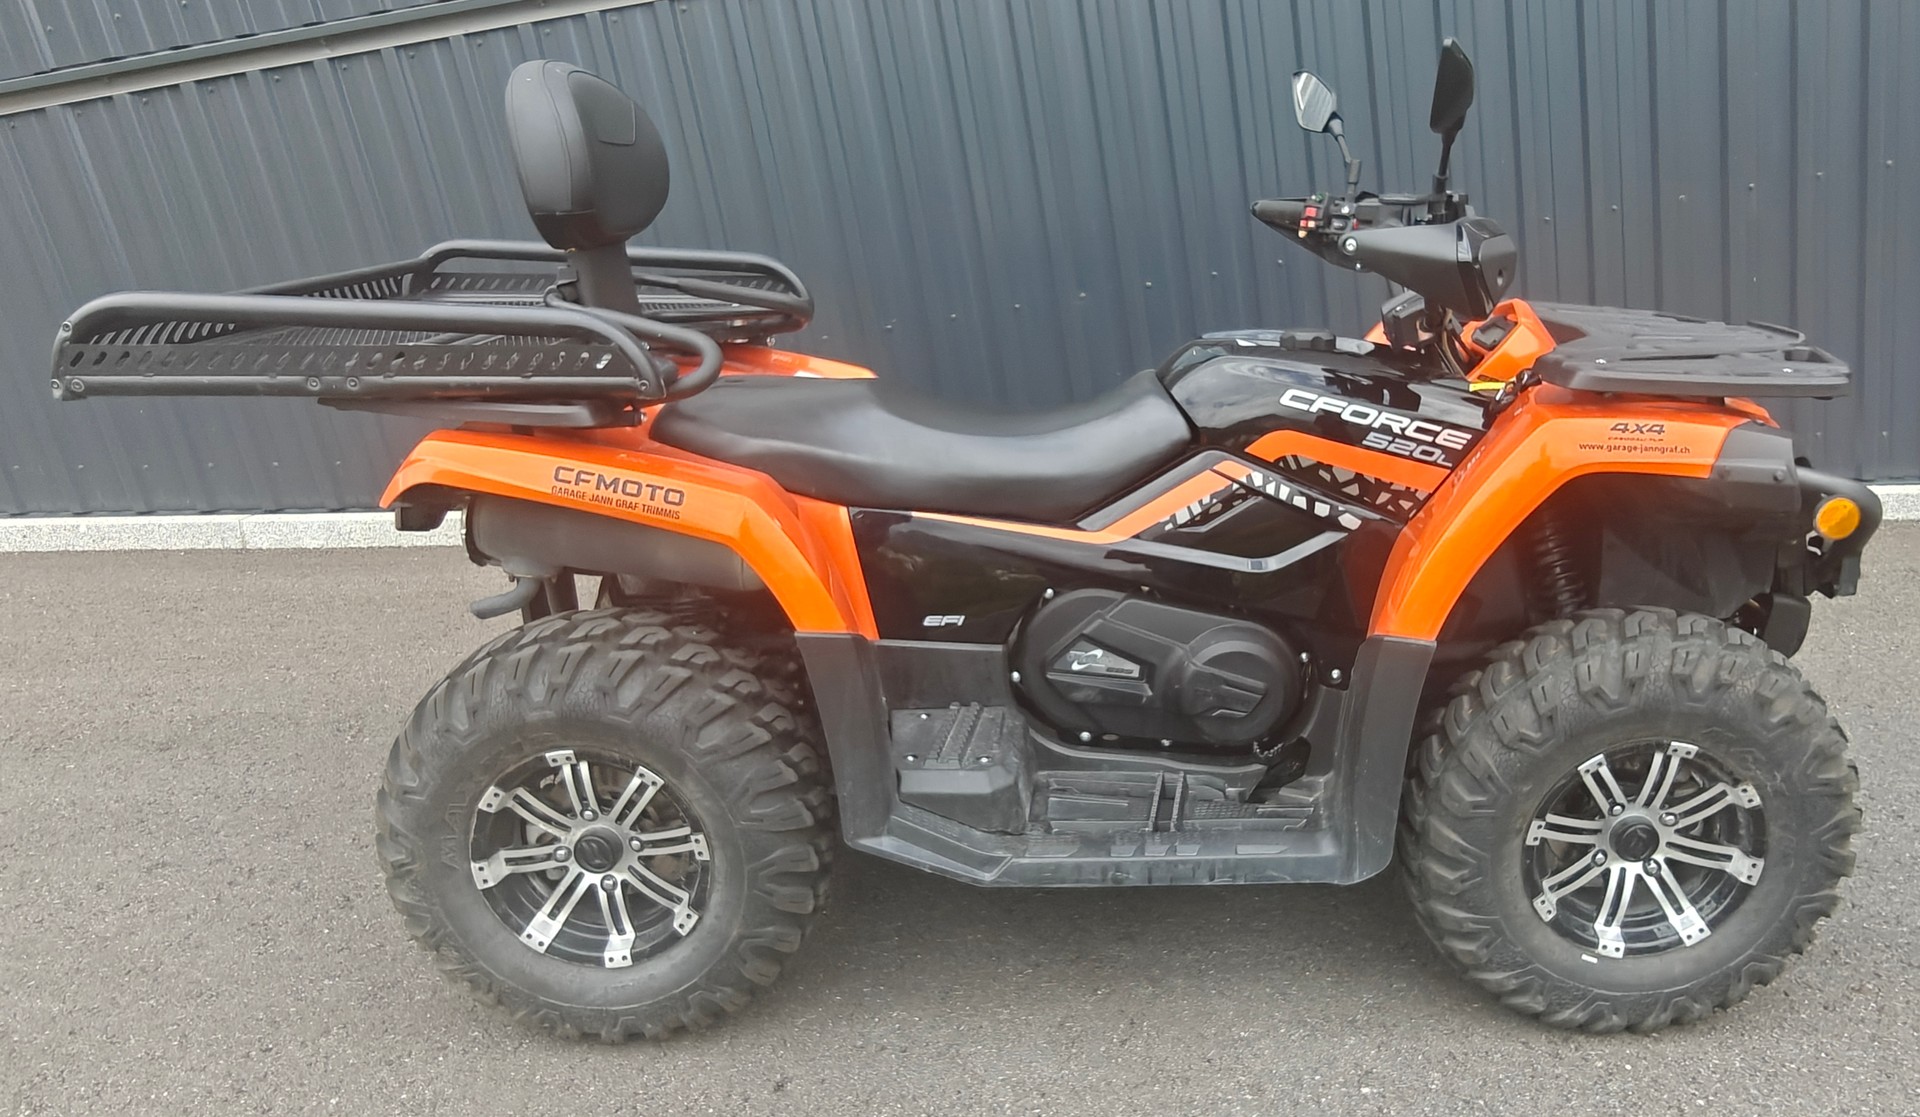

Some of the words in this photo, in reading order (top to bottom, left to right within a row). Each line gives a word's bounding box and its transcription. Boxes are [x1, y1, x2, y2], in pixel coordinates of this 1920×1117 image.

[1279, 388, 1473, 450] CFORCE
[1579, 442, 1690, 454] www.garage-janngraf.ch
[551, 485, 587, 501] GARAGE
[589, 493, 613, 507] JANN
[615, 498, 639, 512] GRAF
[641, 503, 681, 520] TRIMMIS
[553, 465, 685, 507] CFMOTO
[923, 615, 966, 626] EFI
